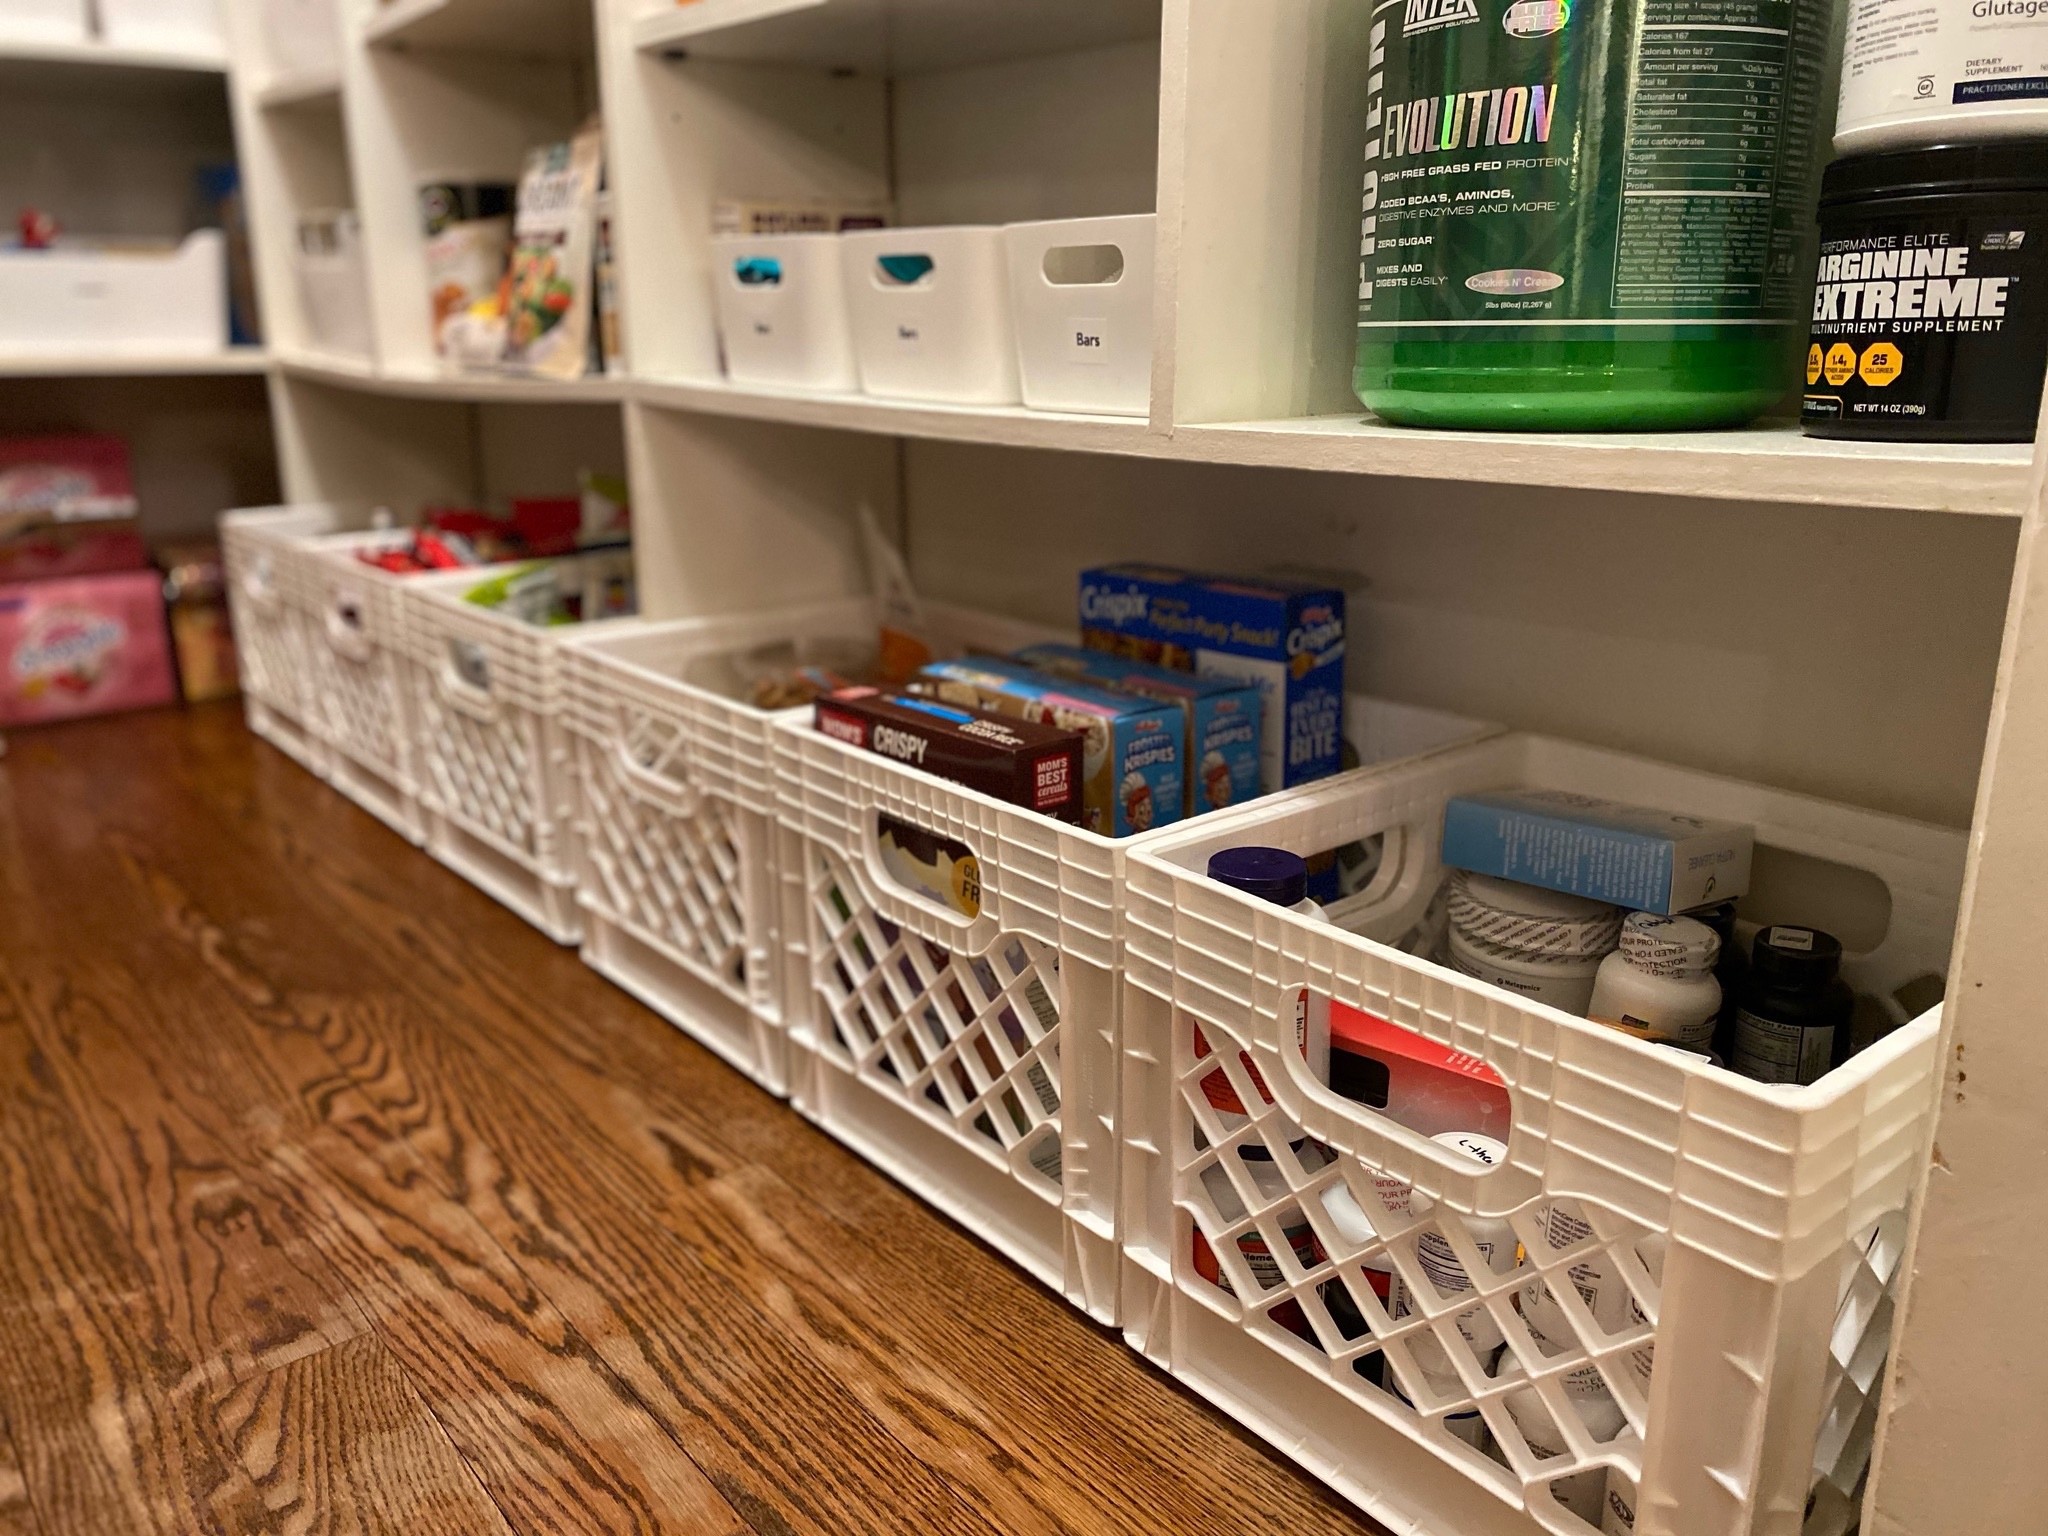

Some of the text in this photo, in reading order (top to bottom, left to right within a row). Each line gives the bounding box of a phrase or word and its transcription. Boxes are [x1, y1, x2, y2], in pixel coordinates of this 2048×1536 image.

[1429, 23, 1444, 32] BODY
[1446, 17, 1480, 29] SOLUTIONS
[1640, 32, 1689, 40] Calories 167
[1638, 48, 1671, 56] Calories
[1693, 48, 1703, 56] fat
[1704, 48, 1713, 56] 27
[1644, 63, 1718, 72] Amount per serving
[1966, 58, 2003, 68] DIETARY
[1965, 65, 2023, 76] SUPPLEMENT
[1962, 83, 2024, 94] PRACTITIONER
[1636, 93, 1676, 101] Saturated
[1677, 93, 1688, 101] fat
[1633, 108, 1678, 116] Cholesterol
[1382, 84, 1558, 160] EVOLUTION
[1651, 138, 1705, 147] carbohydrates
[1628, 152, 1657, 161] Sugars
[1401, 167, 1426, 180] FREE
[1428, 163, 1470, 177] GRASS
[1474, 161, 1502, 172] FED
[1627, 168, 1648, 176] Fiber
[1626, 182, 1654, 190] Protein
[1380, 189, 1515, 209] ADDED BCAA'S, AMINOS,
[1378, 210, 1417, 223] DIGESTIVE
[1419, 205, 1474, 218] ENZYMES
[1478, 203, 1508, 214] AND
[1377, 239, 1397, 249] ZERO
[1903, 233, 1950, 247] ELITE
[1376, 263, 1423, 274] MIXES AND
[1817, 247, 1969, 283] ARGININE
[1375, 278, 1408, 288] DIGESTS
[1812, 277, 2010, 321] EXTREME
[1892, 320, 2004, 333] SUPPLEMENT
[1076, 332, 1101, 347] Bars
[1871, 354, 1888, 366] 25
[1853, 403, 1926, 415] NET WT 14 OZ (390g)
[873, 724, 929, 764] CRISPY
[1037, 757, 1068, 773] MOM'S
[1037, 768, 1068, 787] BEST
[1037, 781, 1068, 797] cereals
[1504, 979, 1541, 992] Metagenics
